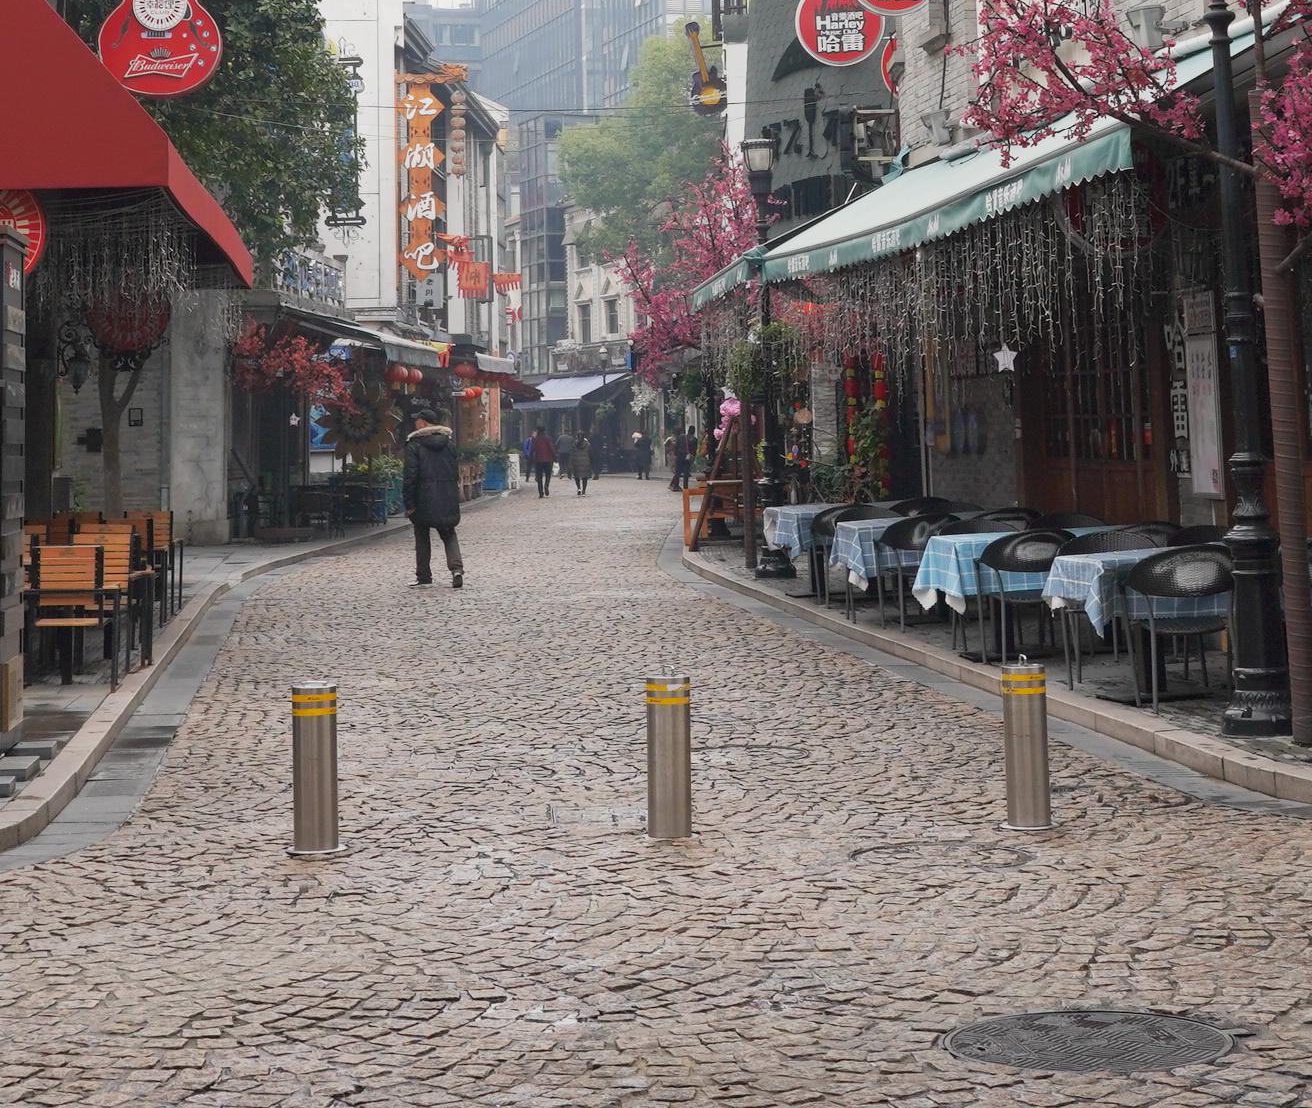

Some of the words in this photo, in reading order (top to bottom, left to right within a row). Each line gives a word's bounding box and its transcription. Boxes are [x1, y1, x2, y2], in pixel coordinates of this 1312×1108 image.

[816, 15, 864, 30] Harley
[818, 34, 864, 52] 哈雷
[129, 59, 191, 72] Budweiser
[404, 94, 439, 270] 江湖酒吧
